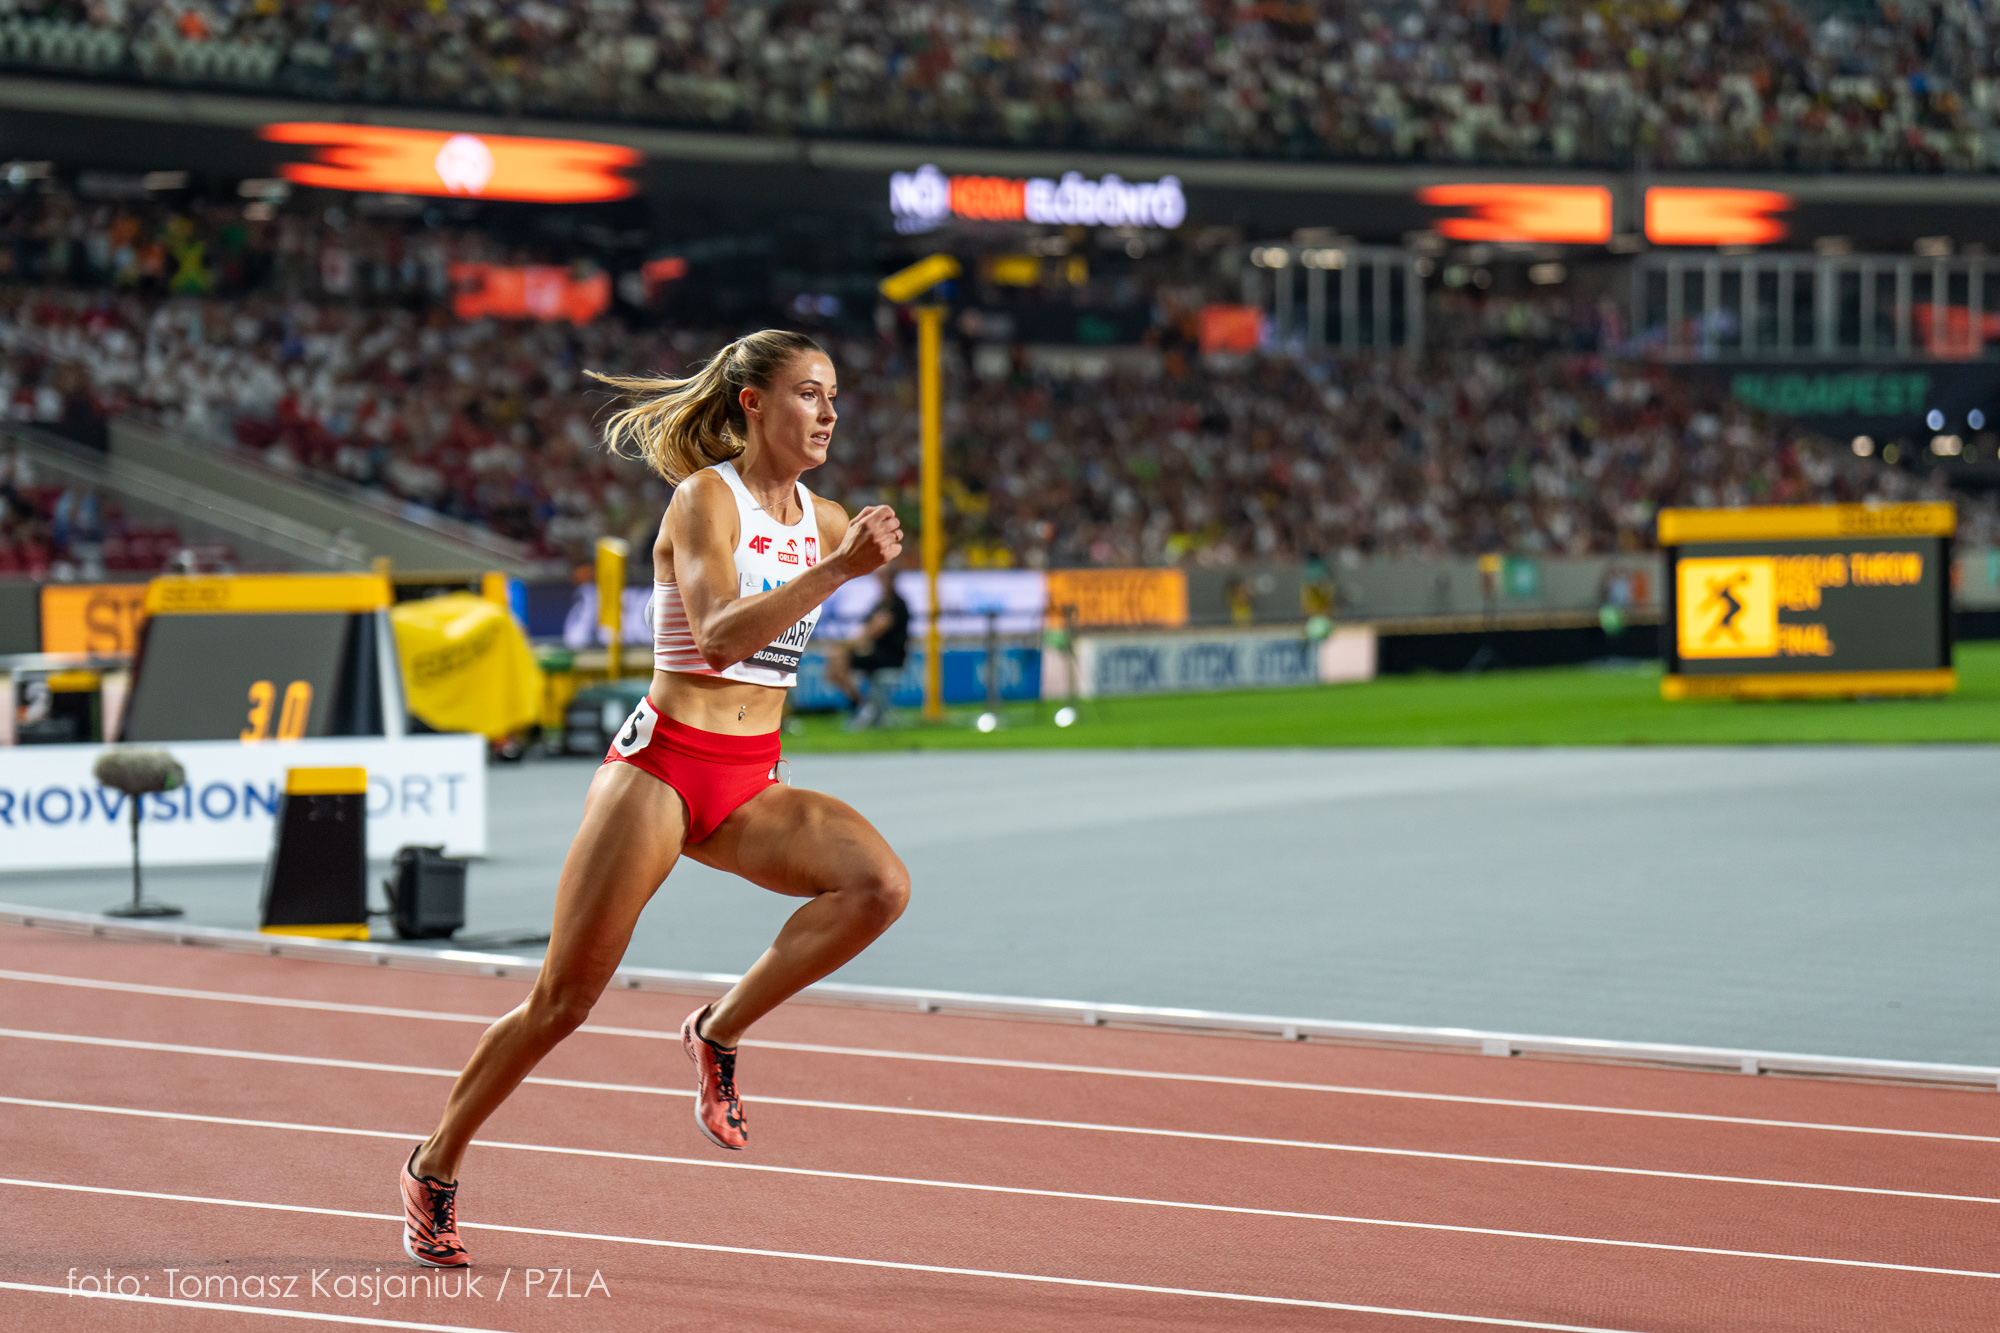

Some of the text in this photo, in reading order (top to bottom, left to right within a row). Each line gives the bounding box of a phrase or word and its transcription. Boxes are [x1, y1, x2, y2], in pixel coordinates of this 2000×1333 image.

[749, 535, 772, 554] 4F
[779, 554, 798, 564] ORLEN
[621, 710, 645, 747] 5
